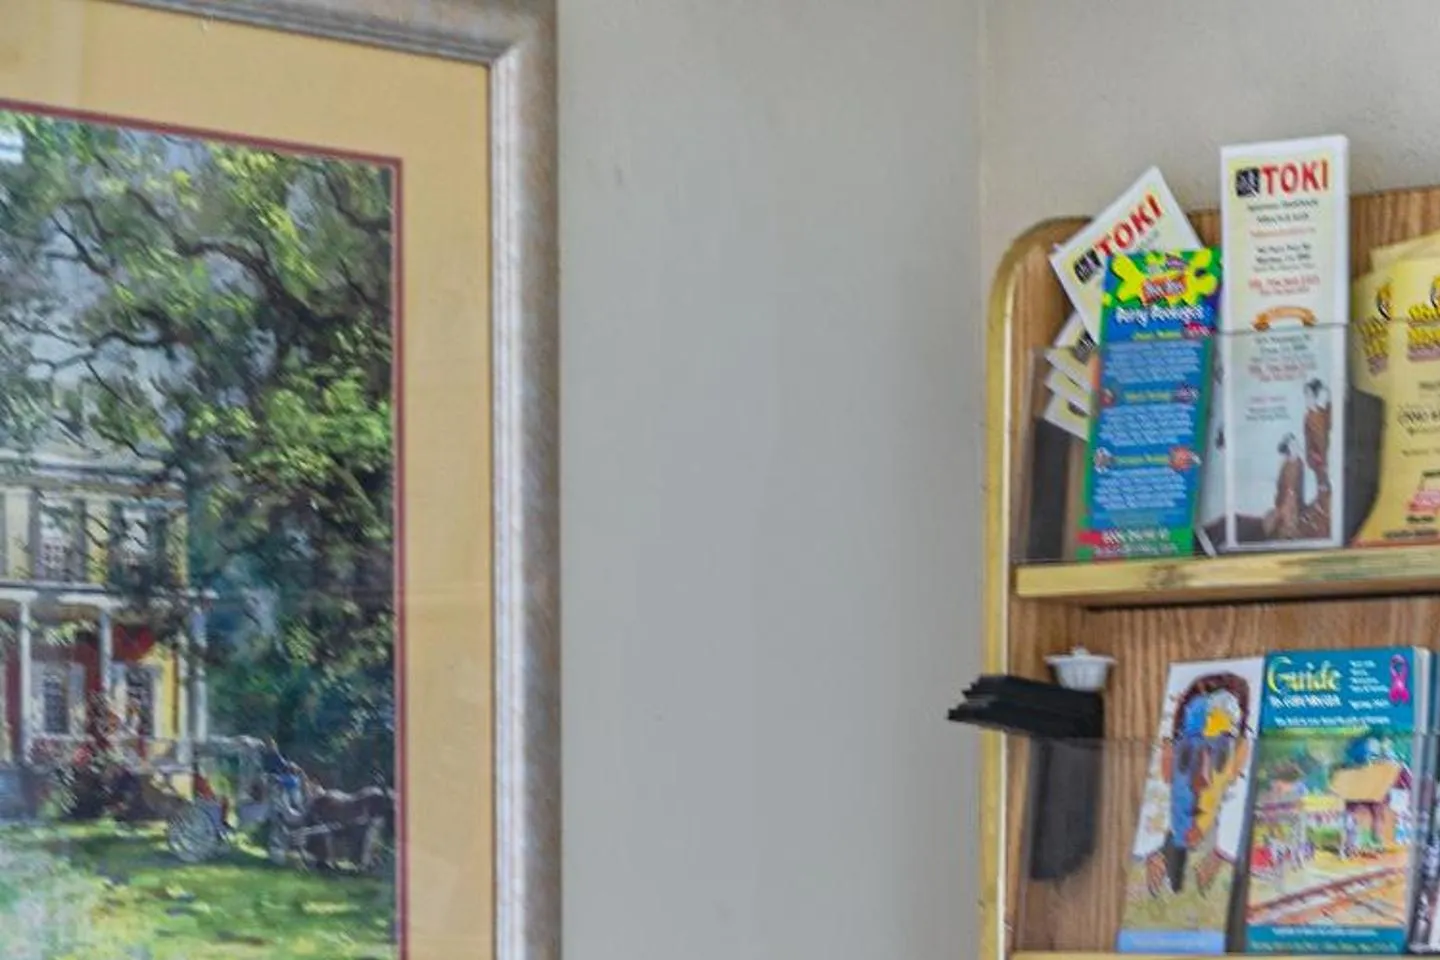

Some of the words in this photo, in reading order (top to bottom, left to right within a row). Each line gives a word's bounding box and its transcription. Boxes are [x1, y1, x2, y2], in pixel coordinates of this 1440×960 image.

[1261, 159, 1328, 195] TOKI
[1093, 193, 1163, 257] TOKI
[1267, 656, 1341, 695] Guide
